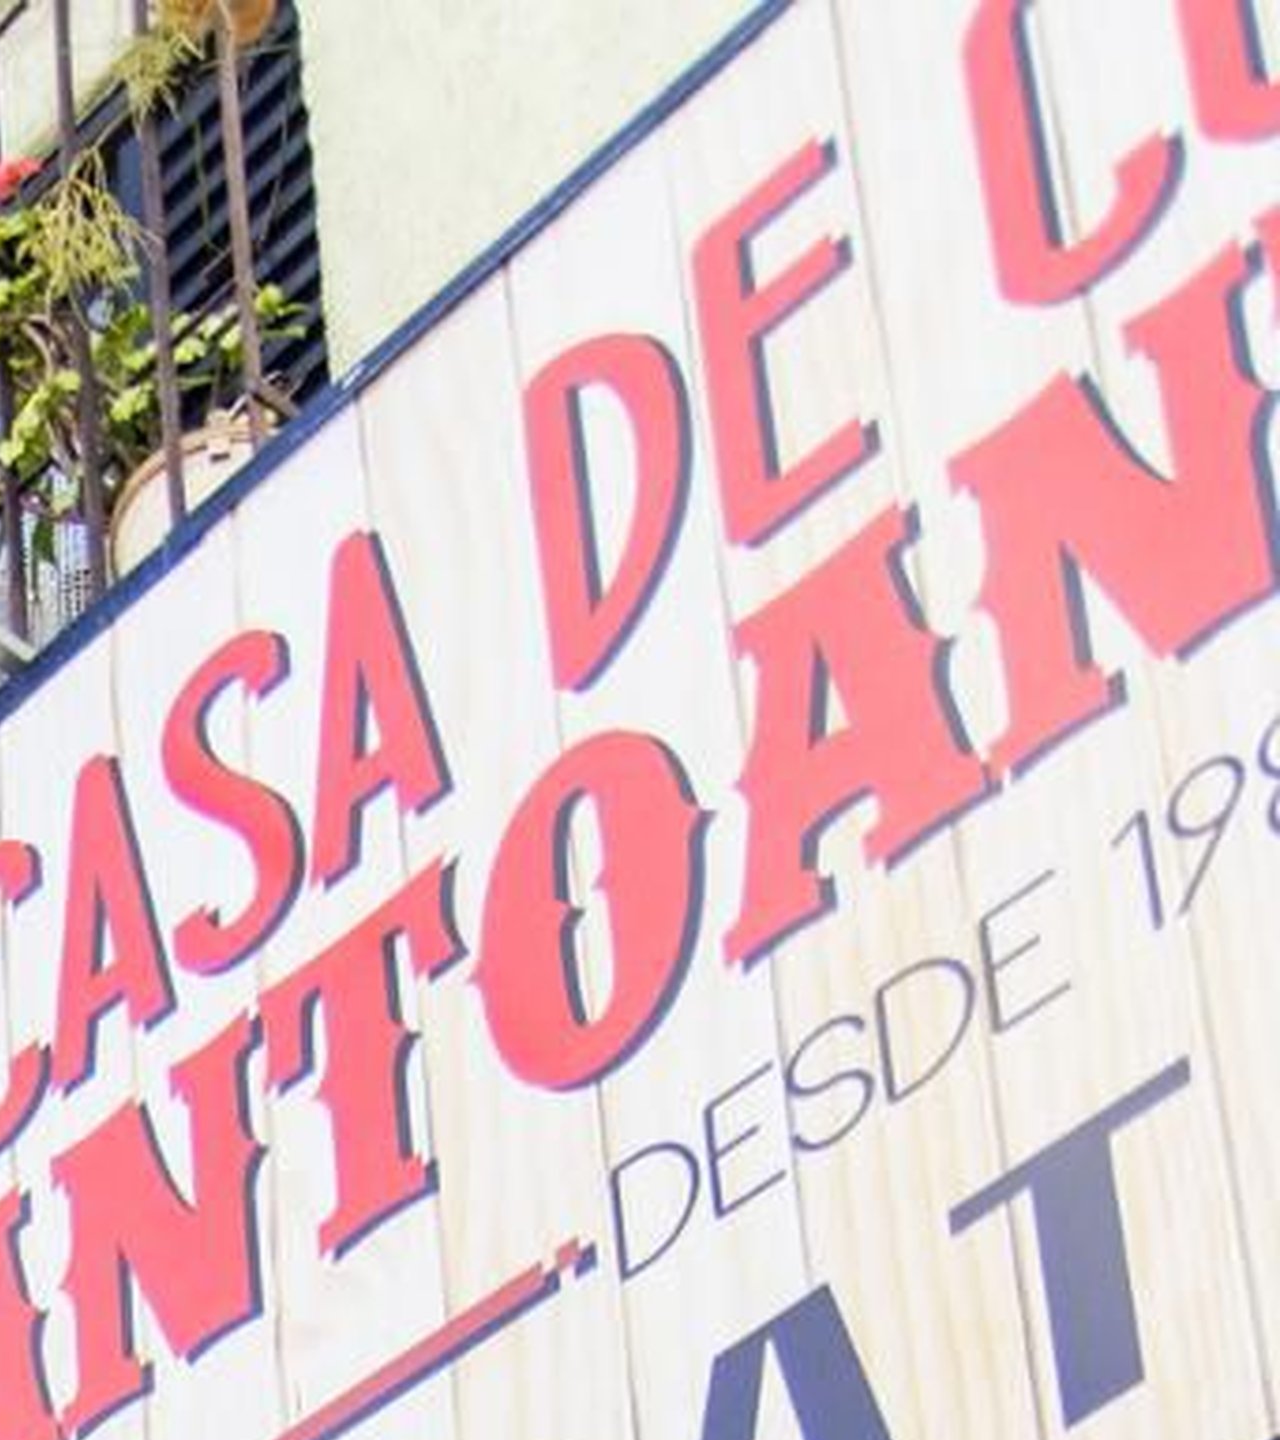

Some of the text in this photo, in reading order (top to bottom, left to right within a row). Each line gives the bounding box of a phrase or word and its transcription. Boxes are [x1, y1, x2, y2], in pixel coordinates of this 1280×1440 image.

[523, 136, 882, 692] DE
[960, 0, 1280, 309] C
[608, 868, 1073, 1283] DESDE
